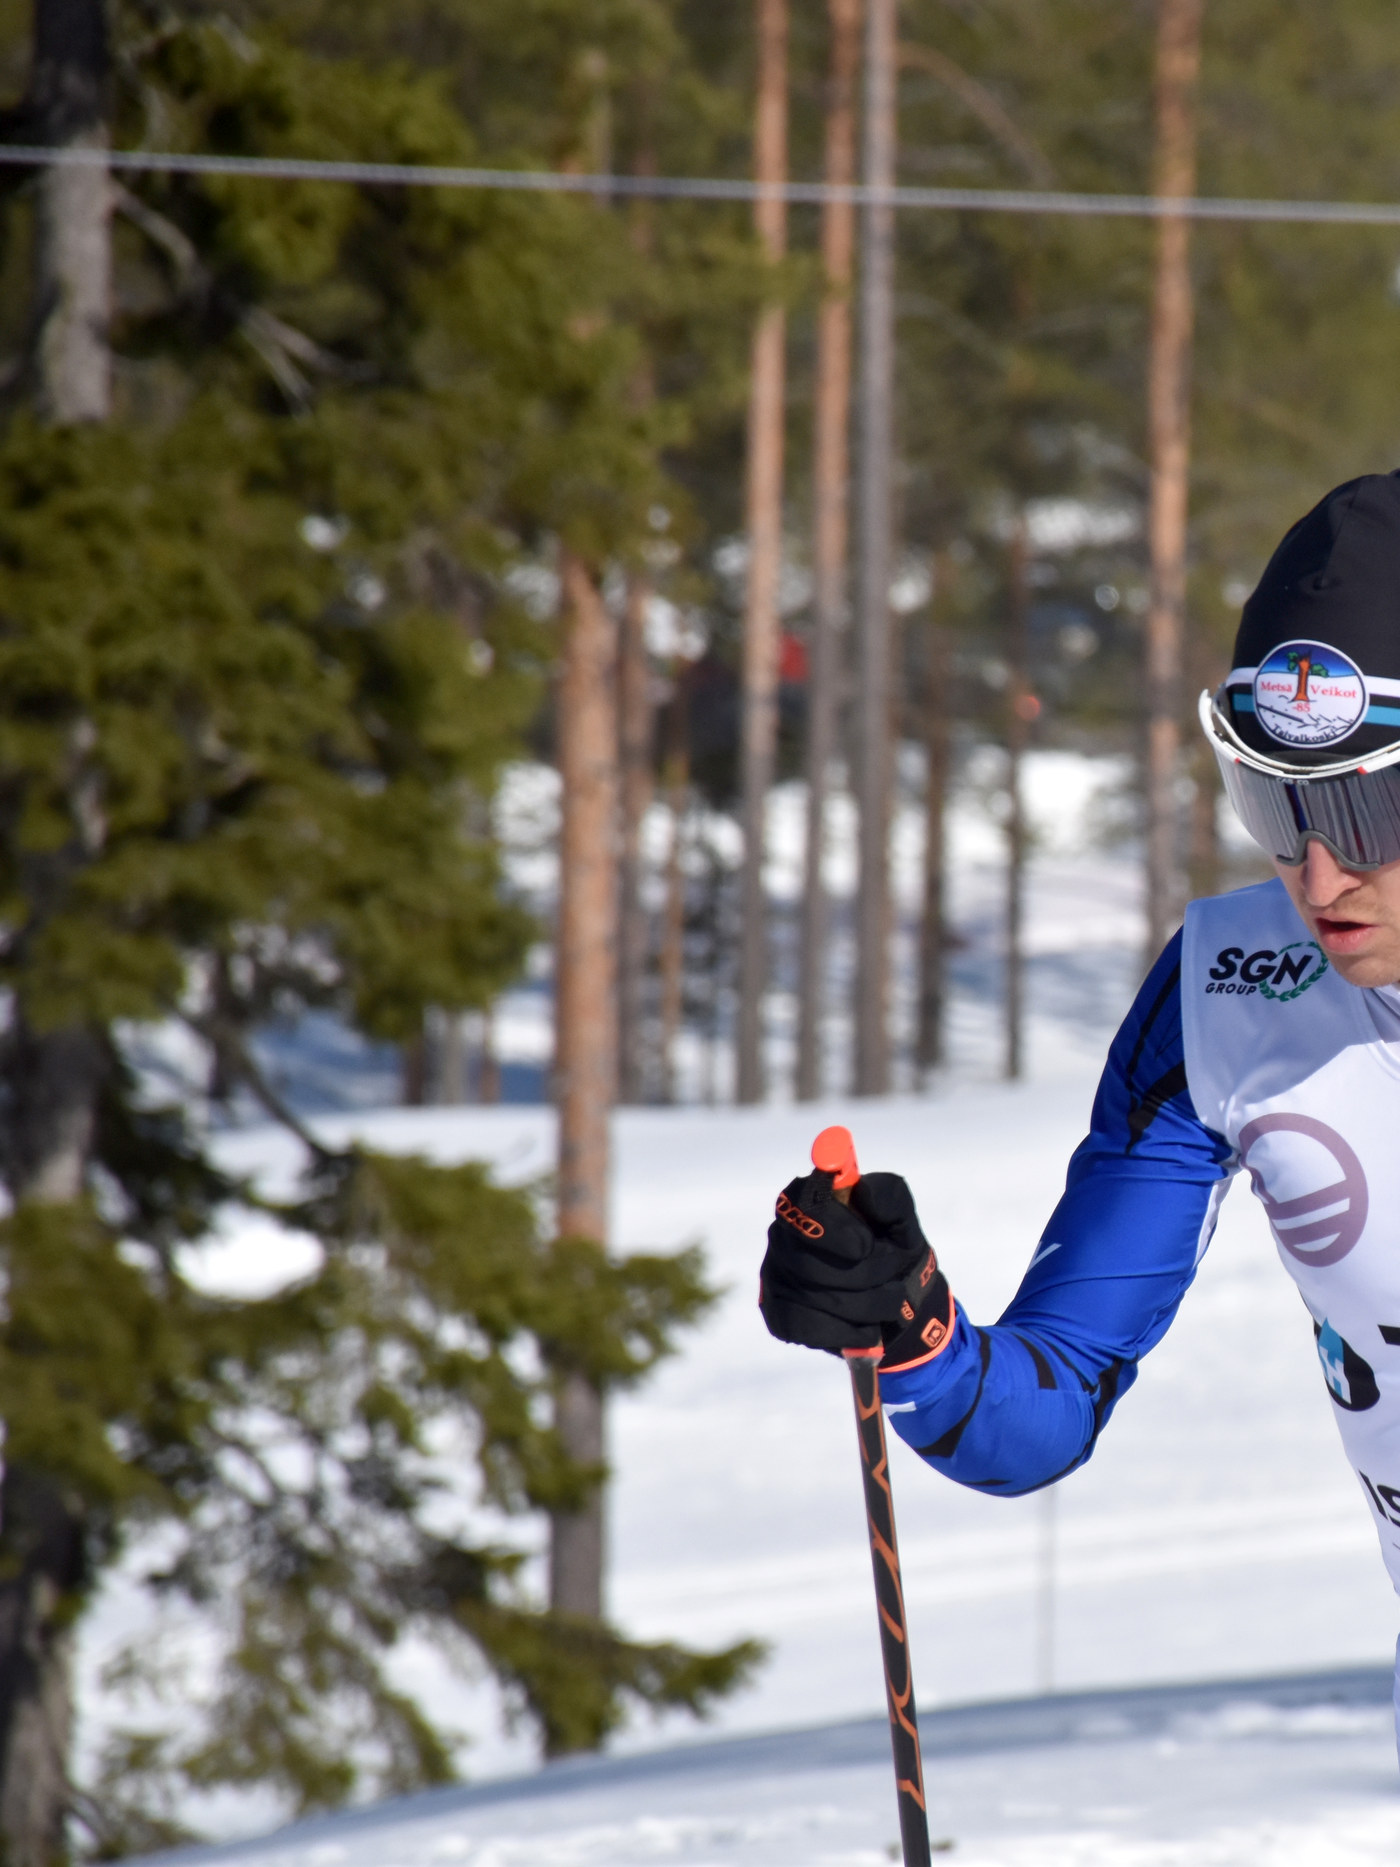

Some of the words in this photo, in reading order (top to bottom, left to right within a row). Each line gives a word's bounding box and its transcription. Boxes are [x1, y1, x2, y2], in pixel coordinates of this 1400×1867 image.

[1260, 681, 1293, 693] Metsä
[1309, 684, 1358, 698] Veikot
[1209, 947, 1314, 986] SGN
[1205, 982, 1258, 996] GROUP
